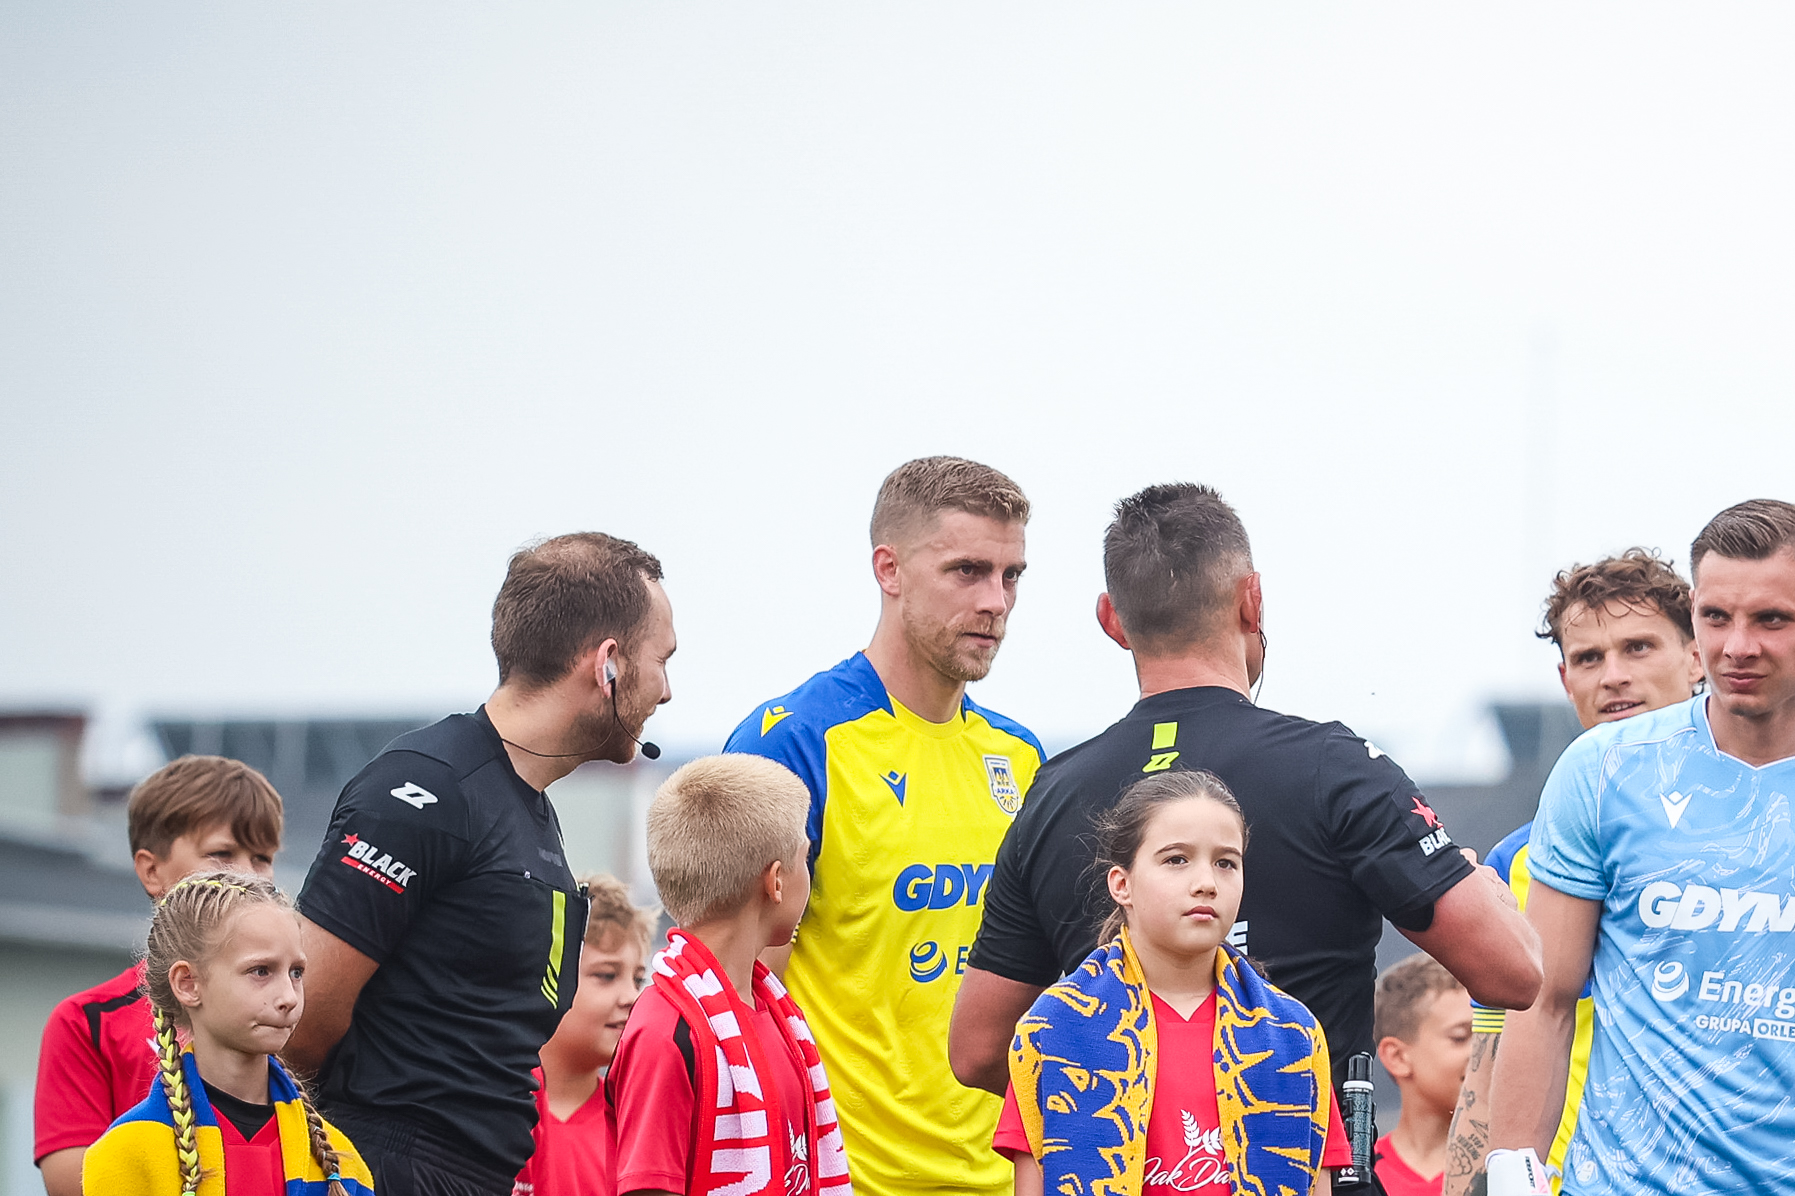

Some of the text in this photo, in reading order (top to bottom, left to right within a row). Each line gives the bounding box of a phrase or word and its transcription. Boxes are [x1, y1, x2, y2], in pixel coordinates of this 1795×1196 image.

[347, 840, 418, 888] BLACK
[357, 863, 392, 886] ENERGY
[893, 863, 996, 912] GDY
[1695, 1014, 1752, 1034] GRUPA
